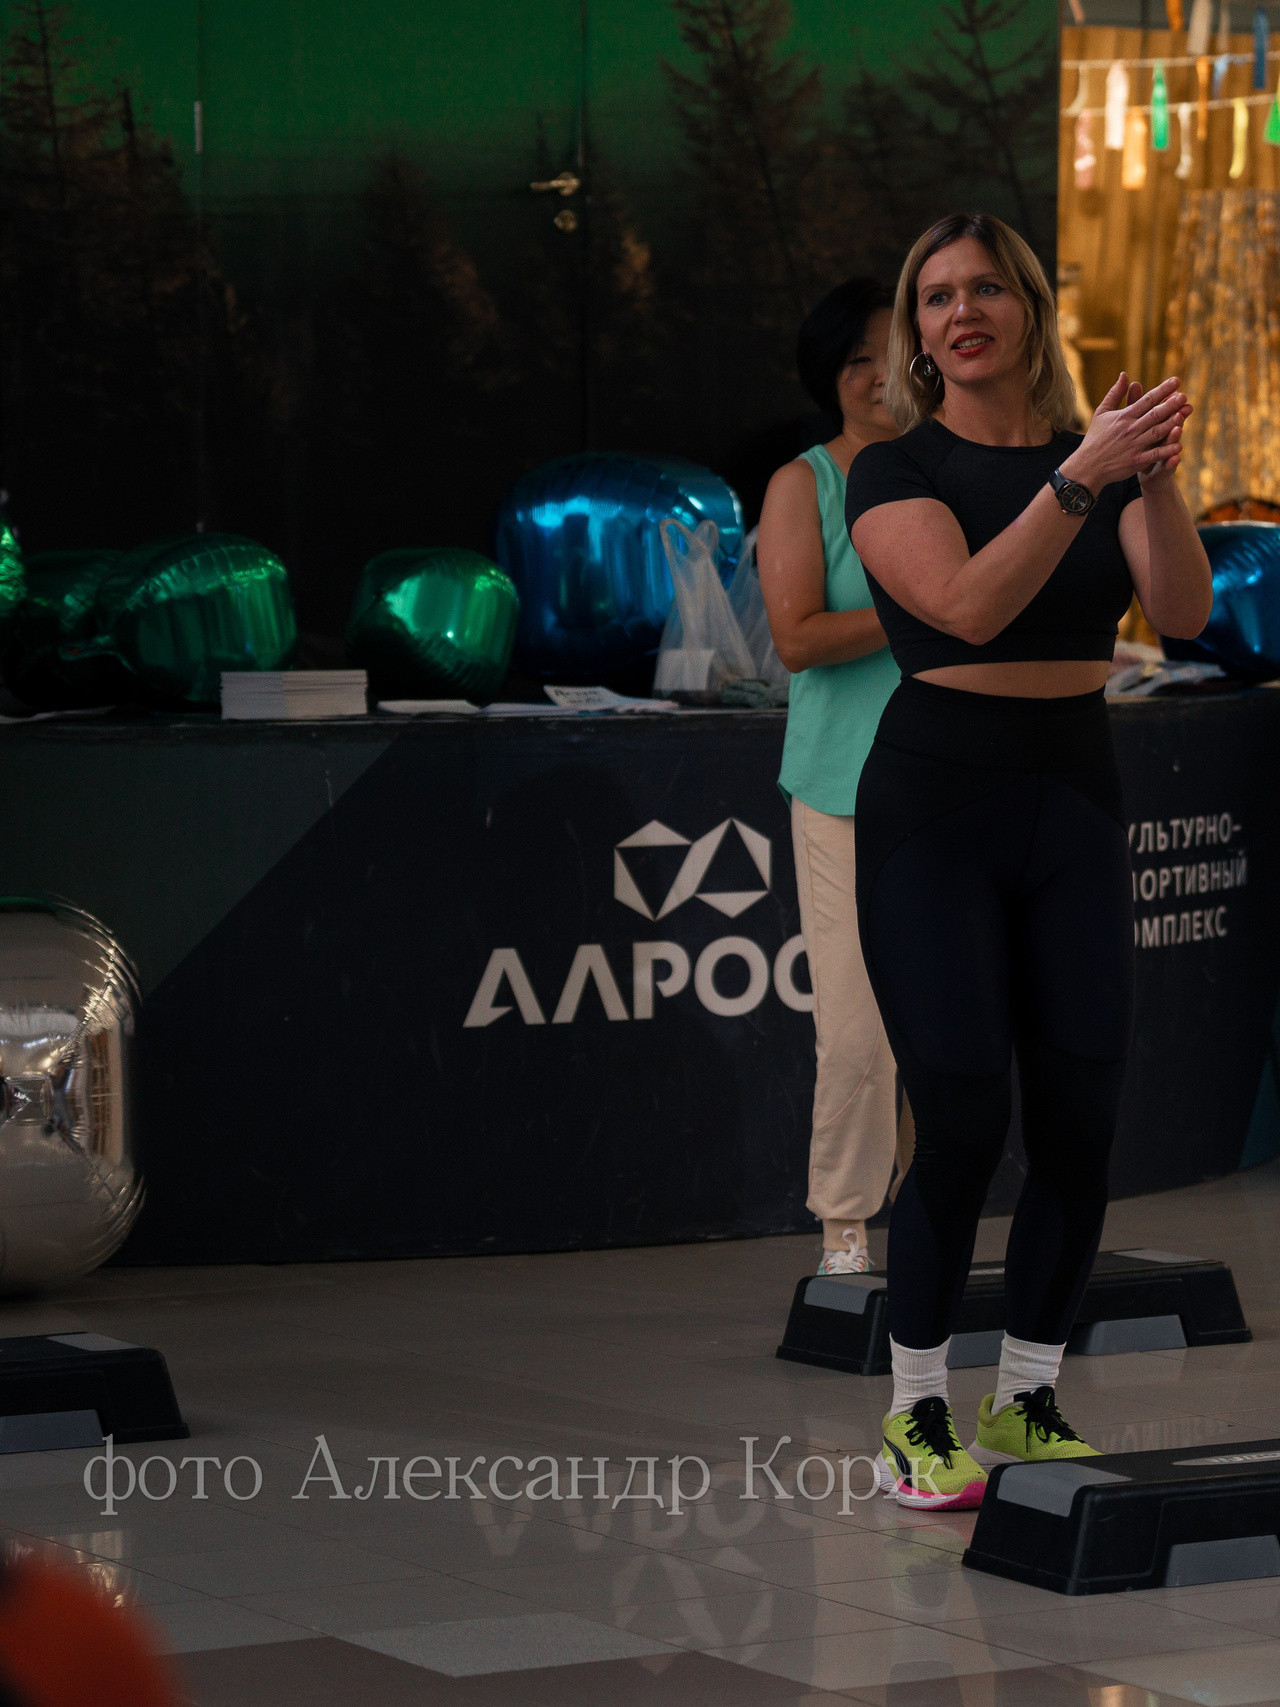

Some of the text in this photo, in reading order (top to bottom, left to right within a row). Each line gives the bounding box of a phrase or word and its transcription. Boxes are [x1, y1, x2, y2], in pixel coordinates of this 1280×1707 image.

[1129, 812, 1242, 854] УЛЬТУРНО-
[1133, 849, 1248, 902] ОРТИВНЫЙ
[1134, 905, 1228, 948] МПЛЕКС
[463, 934, 815, 1028] АЛРОС
